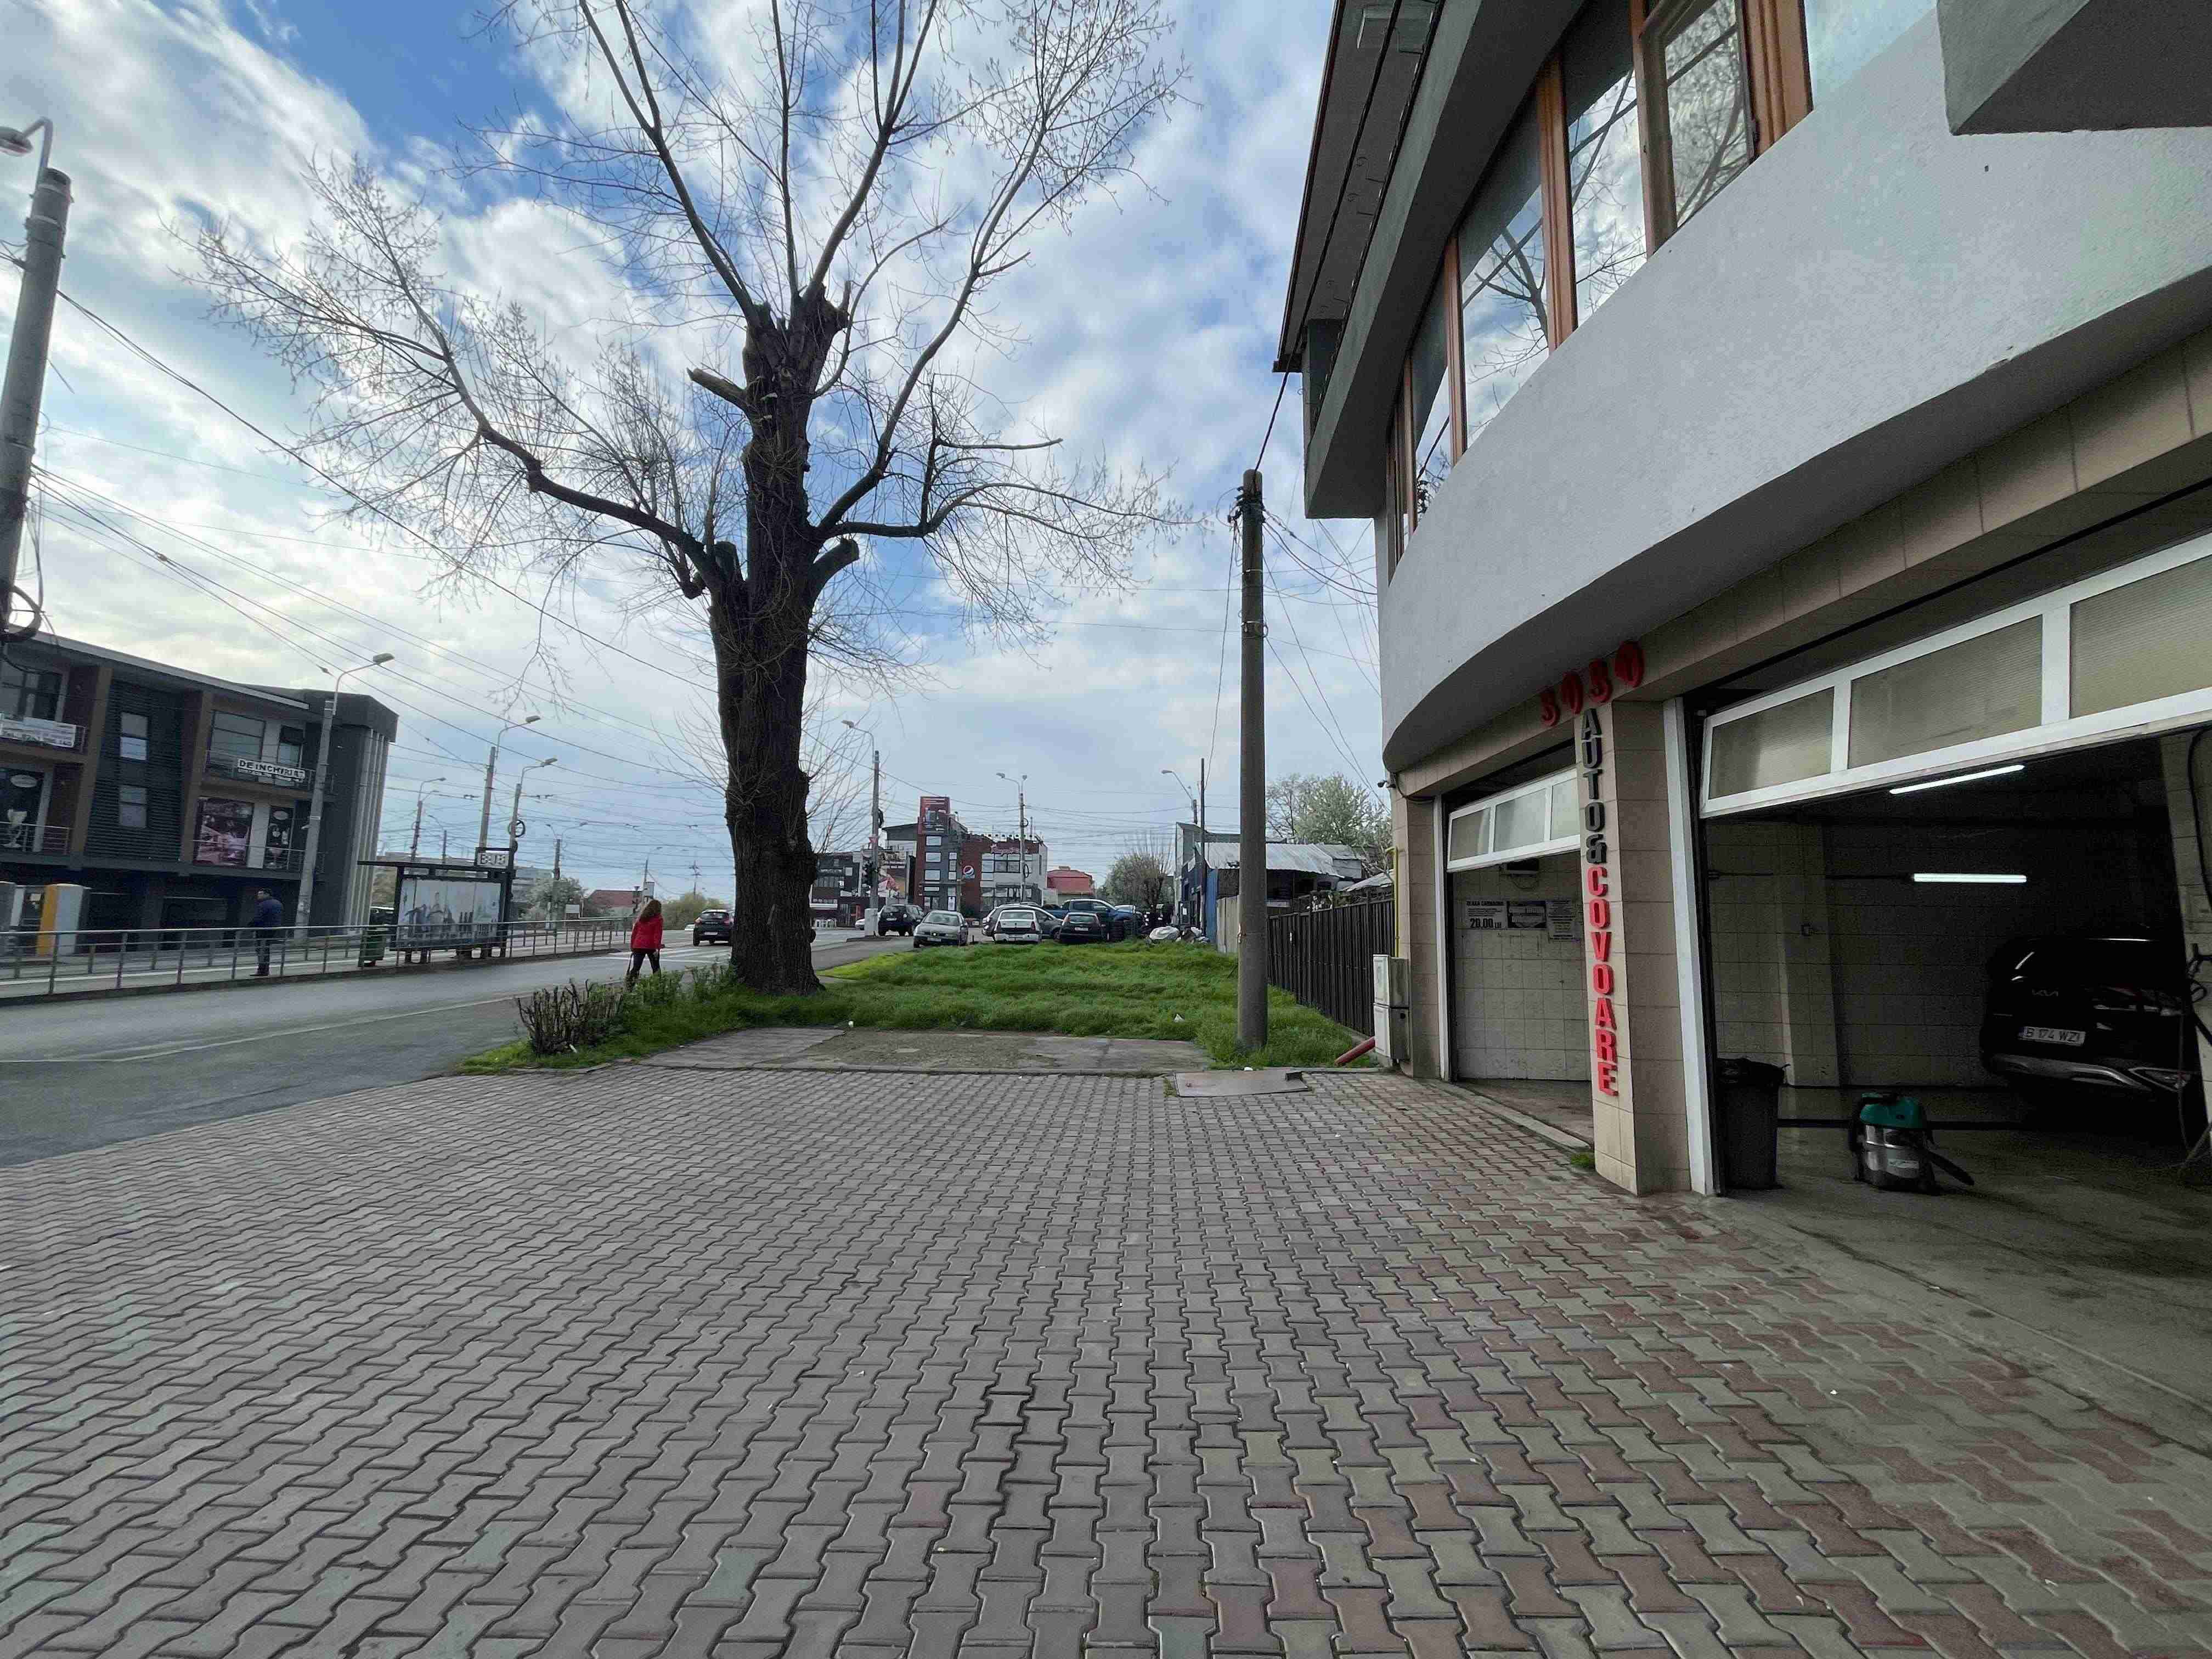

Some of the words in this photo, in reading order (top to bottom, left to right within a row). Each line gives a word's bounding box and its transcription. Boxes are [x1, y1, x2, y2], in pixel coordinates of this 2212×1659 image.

[239, 759, 254, 769] DE
[1581, 708, 1605, 832] AUTO
[480, 854, 505, 865] BUS
[1587, 866, 1619, 1097] COVOARE
[2027, 1028, 2035, 1037] B
